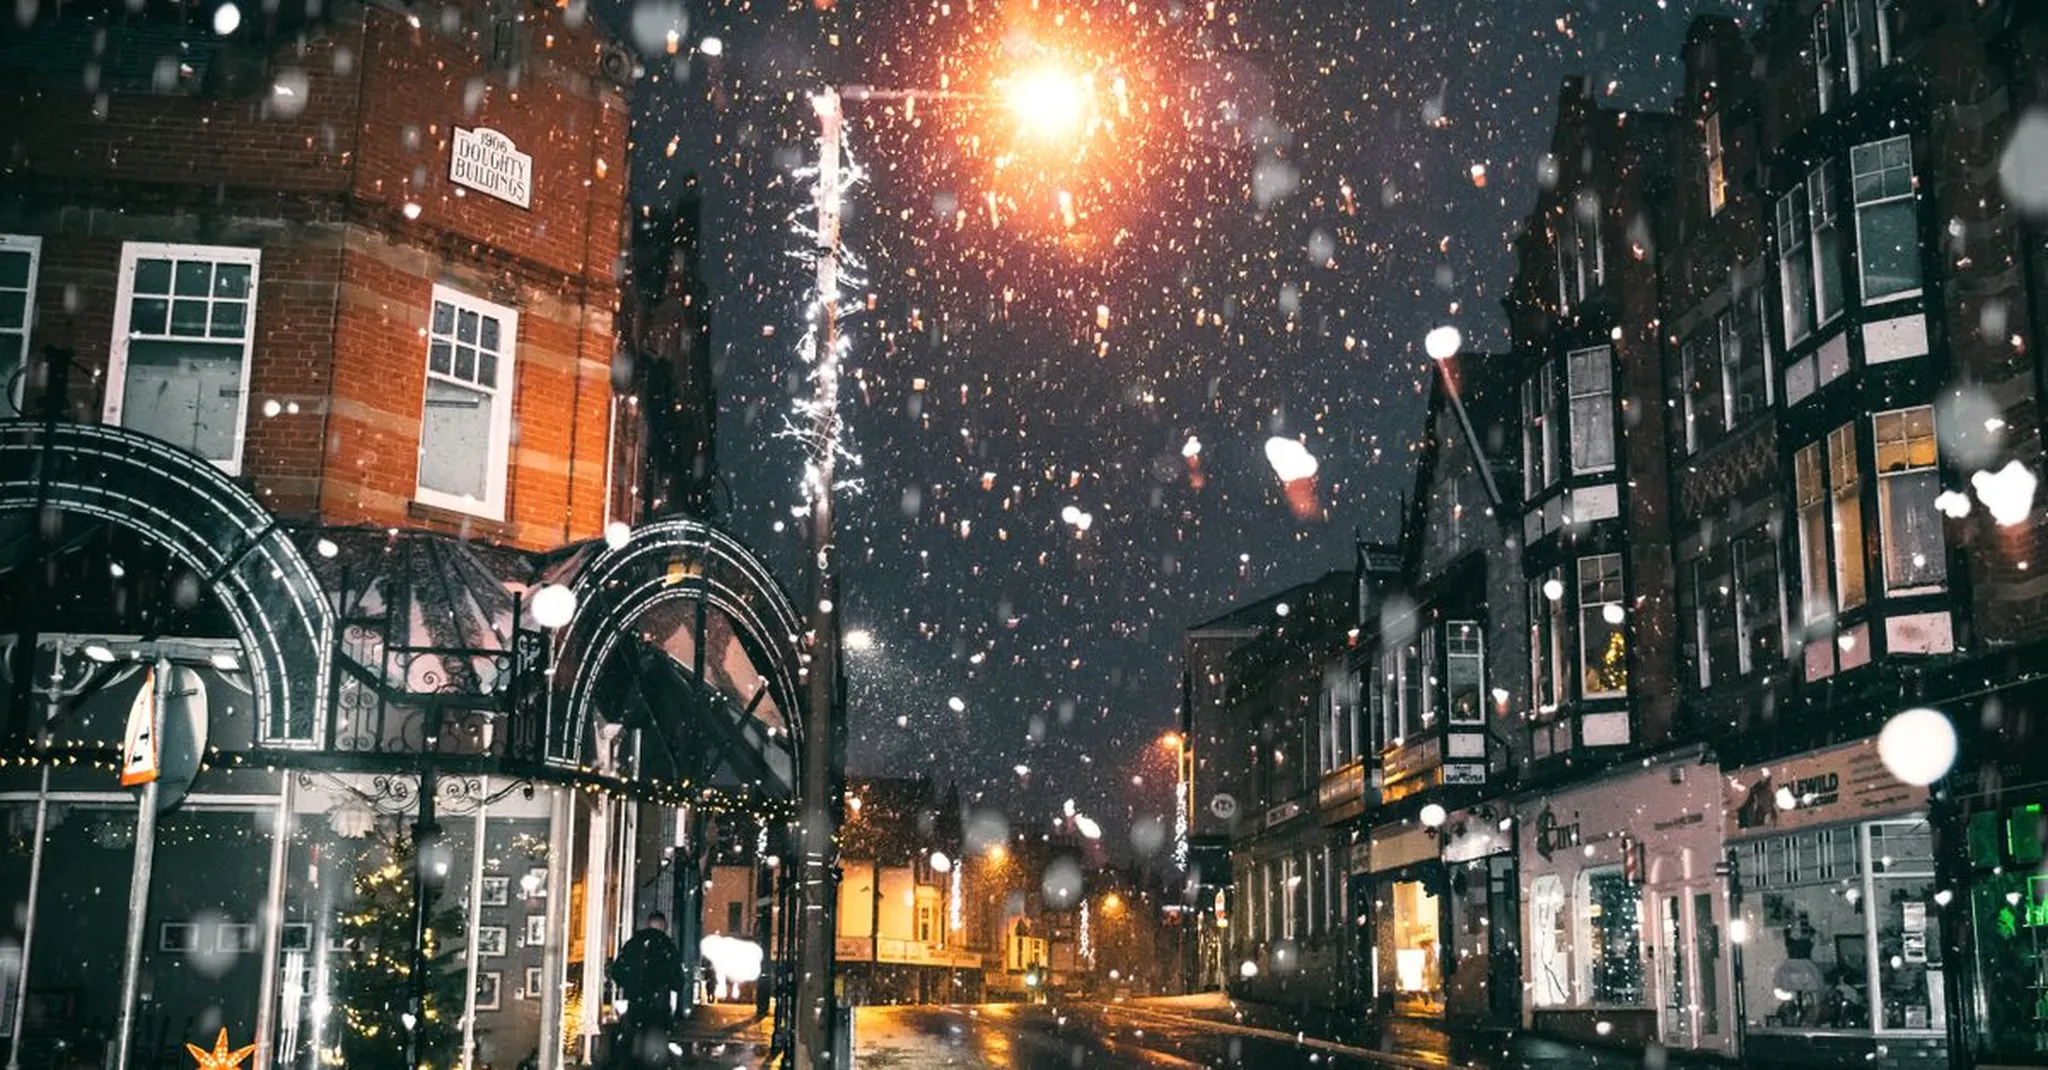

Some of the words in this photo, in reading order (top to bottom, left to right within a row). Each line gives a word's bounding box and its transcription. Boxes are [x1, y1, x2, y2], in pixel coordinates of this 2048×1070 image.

[459, 138, 526, 179] DOUGHTY
[480, 133, 507, 152] 1906
[455, 158, 525, 200] BUILDINGS
[1779, 772, 1839, 798] LEWILD
